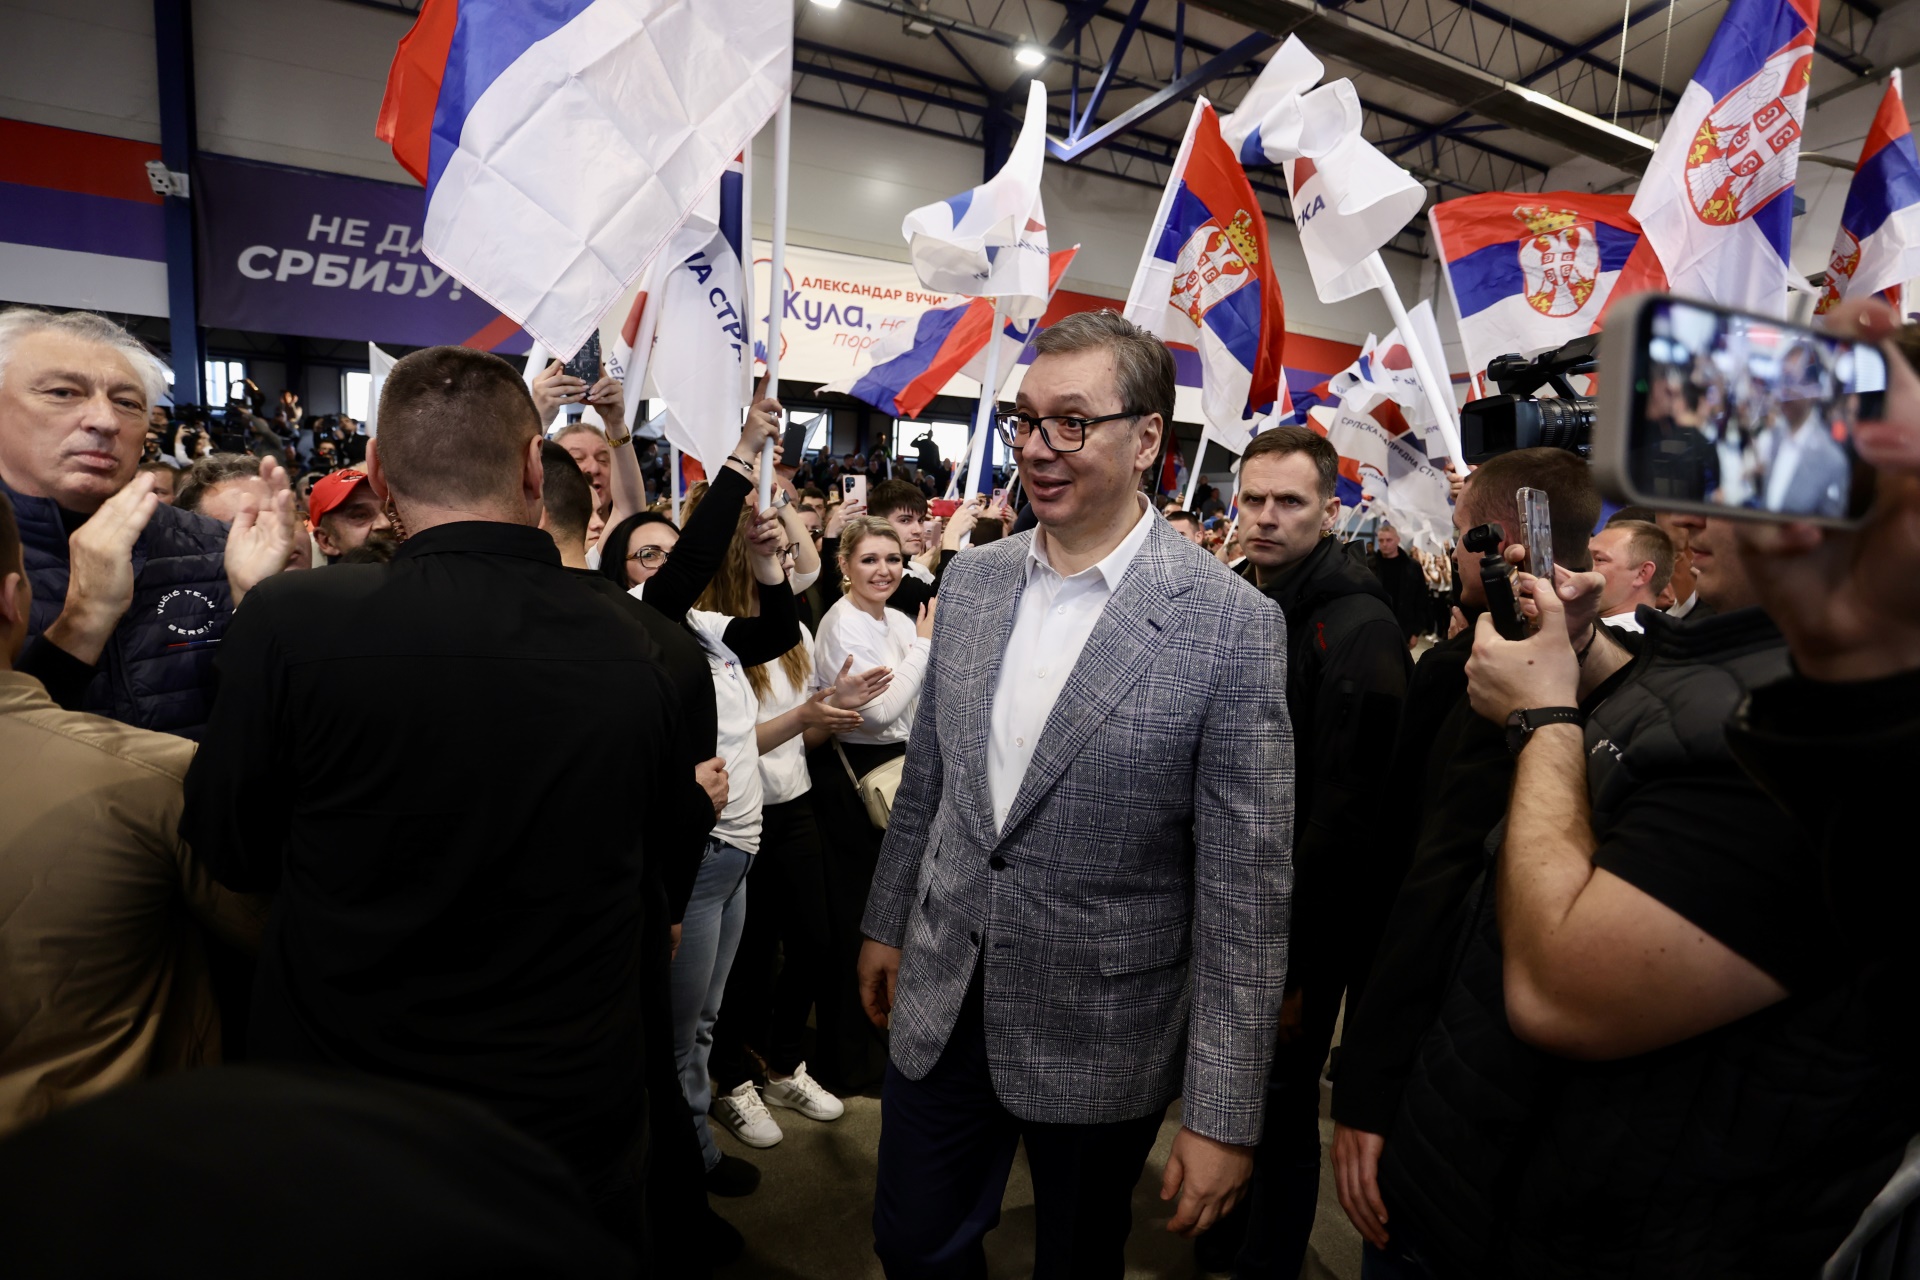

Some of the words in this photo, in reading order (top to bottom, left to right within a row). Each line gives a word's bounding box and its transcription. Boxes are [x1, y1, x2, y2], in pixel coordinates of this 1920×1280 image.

[307, 214, 370, 248] НЕ
[237, 245, 464, 301] СРБИЈУ!
[801, 276, 903, 301] АЛЕКСАНДАР
[906, 291, 949, 306] ВУЧИ
[783, 289, 872, 331] Кула,
[833, 333, 880, 367] пор
[1341, 416, 1379, 435] СРПСКА
[157, 590, 181, 615] VUČIĆ
